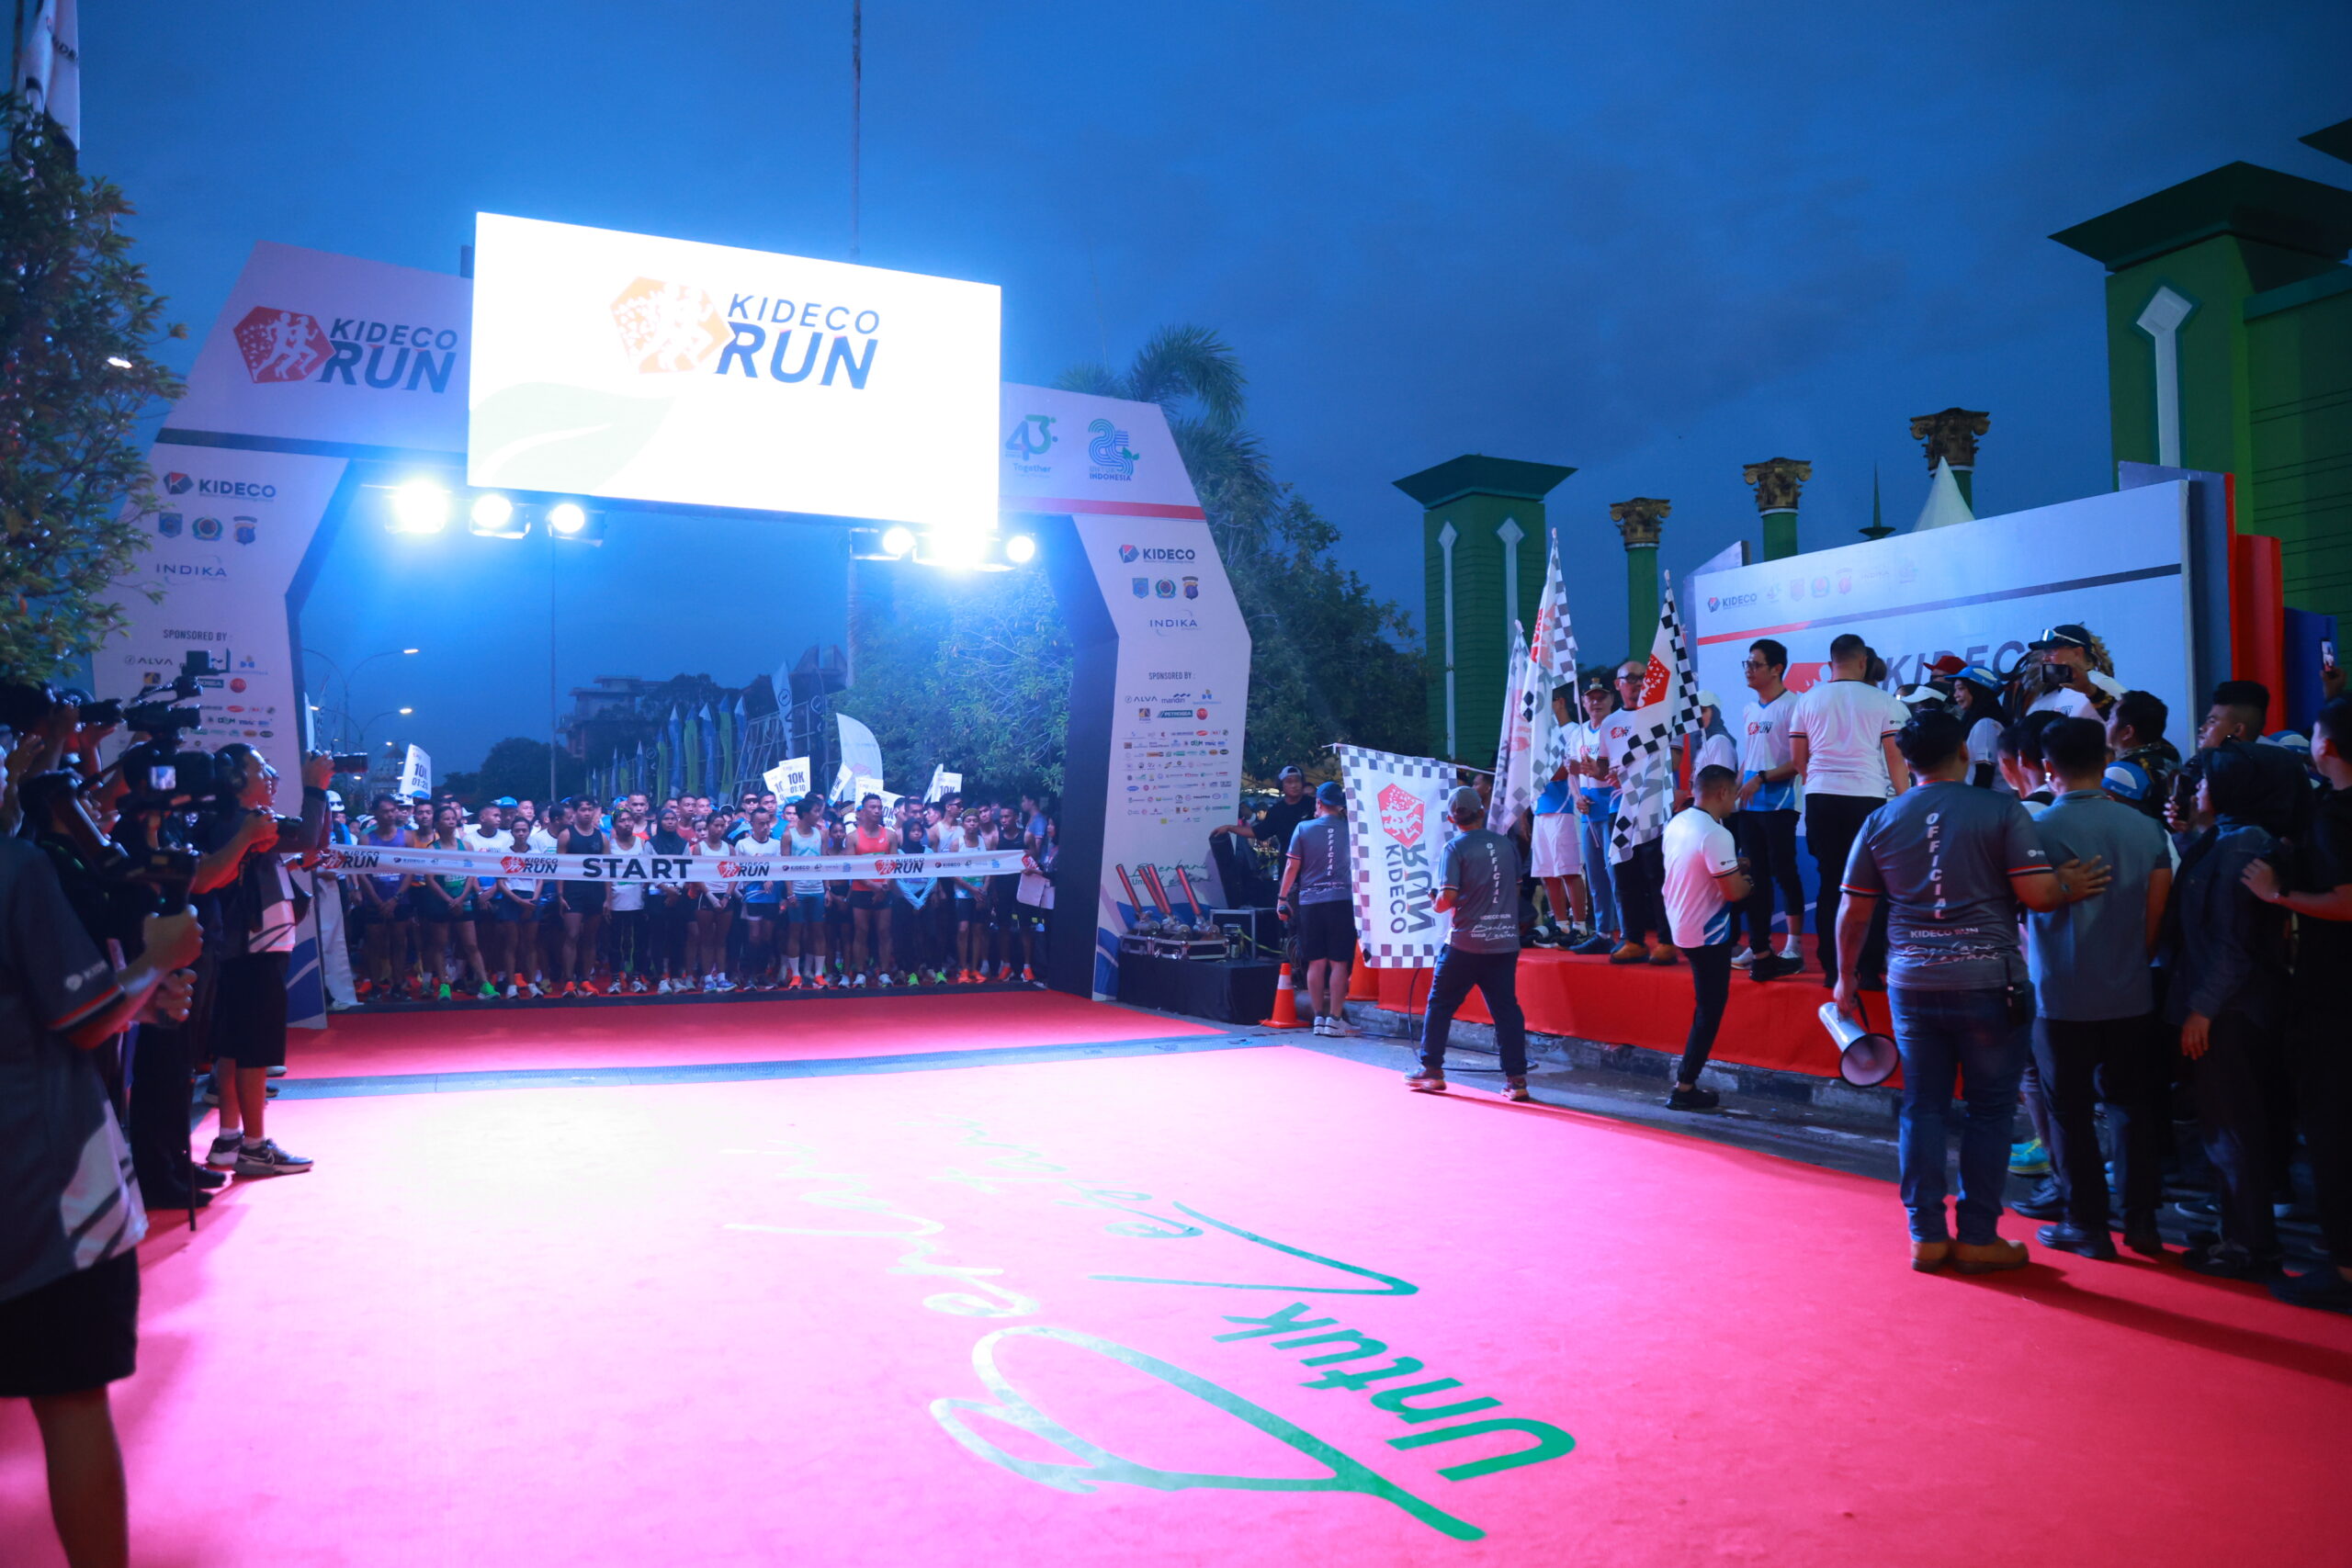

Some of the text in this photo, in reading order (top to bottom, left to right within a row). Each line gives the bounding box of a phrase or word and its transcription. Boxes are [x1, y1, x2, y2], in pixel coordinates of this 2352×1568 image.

[728, 293, 880, 334] KIDECO
[330, 318, 458, 350] KIDECO
[714, 321, 878, 390] RUN
[315, 340, 457, 394] RUN
[1090, 473, 1132, 482] INDONESIA
[199, 479, 276, 498] KIDECO
[1143, 548, 1195, 560] KIDECO
[156, 563, 227, 577] INDIKA
[1722, 593, 1758, 607] KIDECO
[1149, 619, 1198, 627] INDIKA
[164, 629, 228, 641] SPONSORED BY
[1148, 671, 1192, 680] SPONSORED BY
[787, 772, 805, 784] 10K
[790, 784, 806, 794] 01:10
[1327, 828, 1335, 876] OFFICIAL
[342, 855, 379, 868] RUN
[525, 857, 559, 865] KIDECO
[1926, 812, 1947, 919] OFFICIAL
[523, 863, 558, 874] RUN
[582, 858, 693, 879] START
[737, 865, 770, 877] RUN
[894, 863, 924, 874] RUN
[1486, 842, 1501, 904] OFFICIAL
[1385, 843, 1407, 934] KIDECO
[1401, 840, 1436, 933] RUN
[1911, 929, 1952, 938] KIDECO
[1211, 1303, 1577, 1482] Untuk
